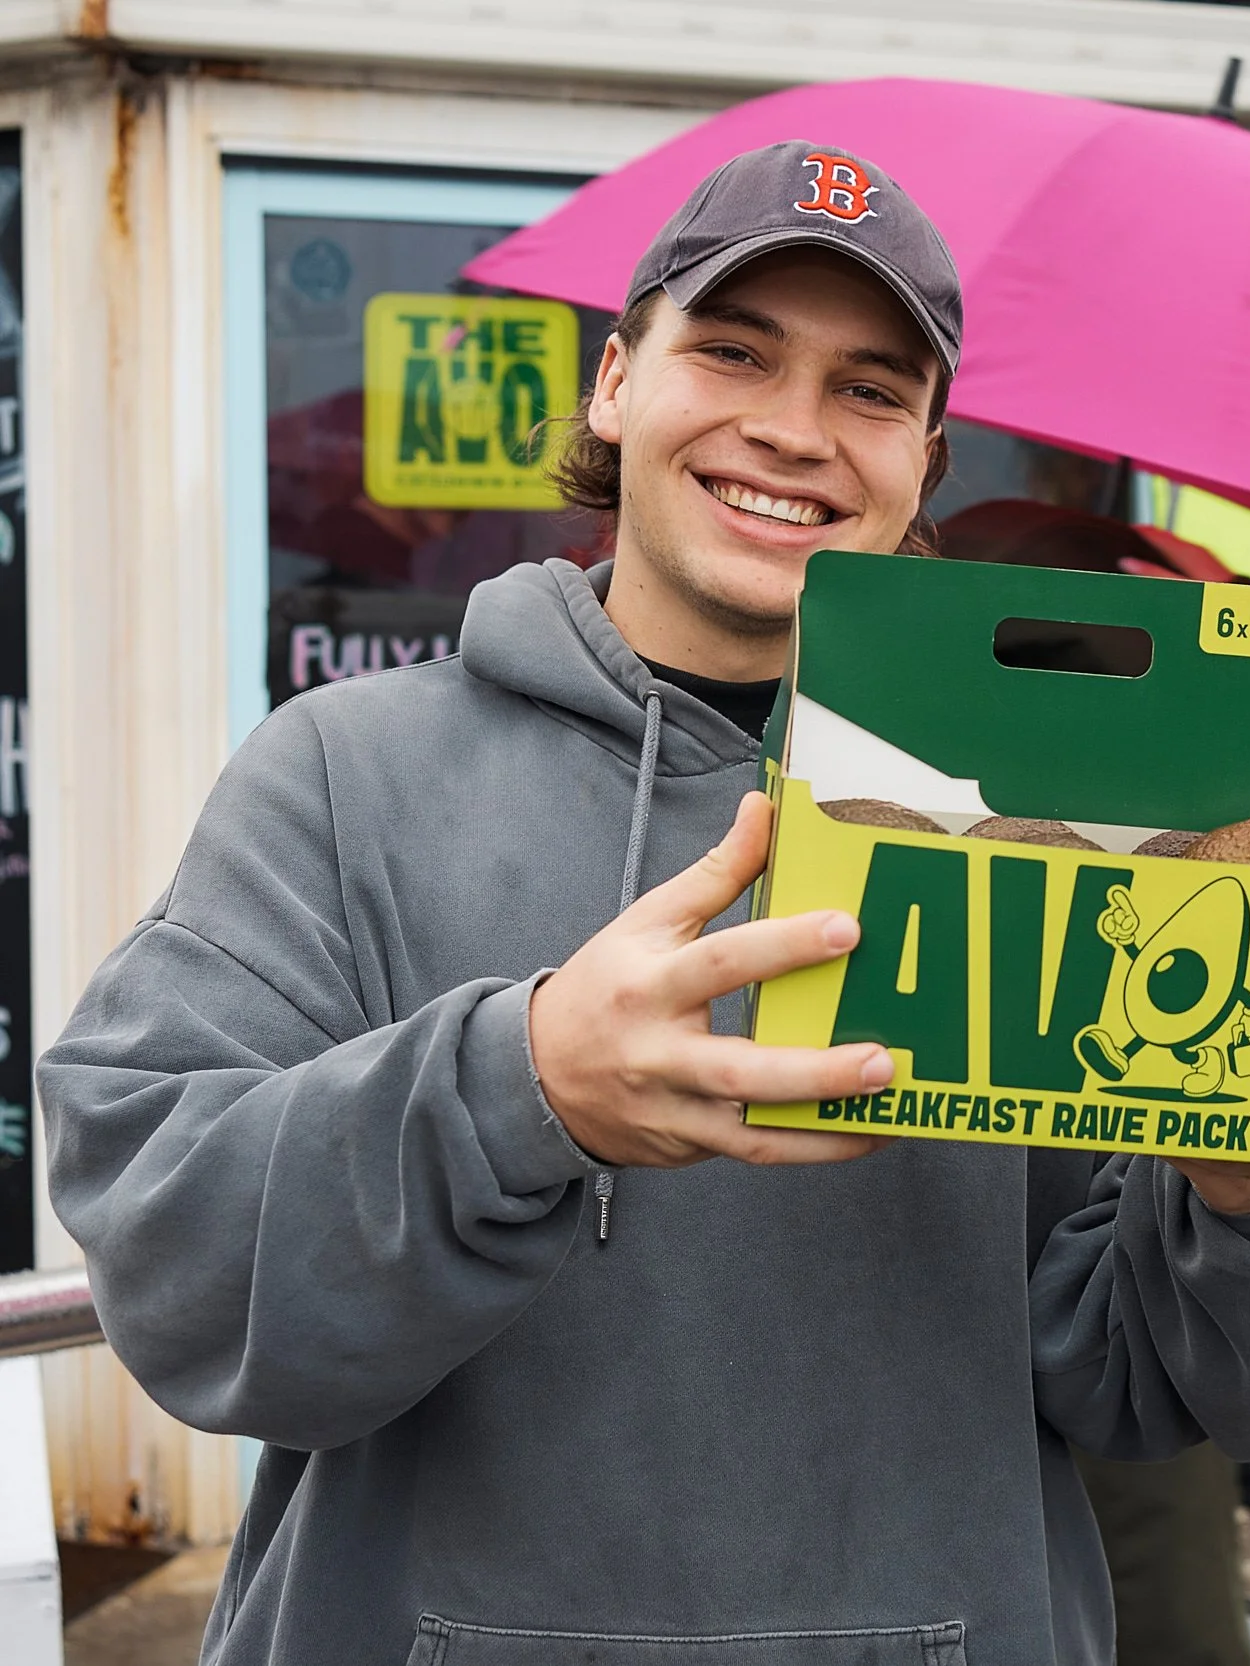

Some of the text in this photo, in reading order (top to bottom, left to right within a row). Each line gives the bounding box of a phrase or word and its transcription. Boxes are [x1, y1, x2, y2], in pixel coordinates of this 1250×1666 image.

[794, 152, 880, 224] B
[397, 315, 546, 356] THE
[817, 1087, 1044, 1136] BREAKFAST
[1051, 1102, 1148, 1144] RAVE
